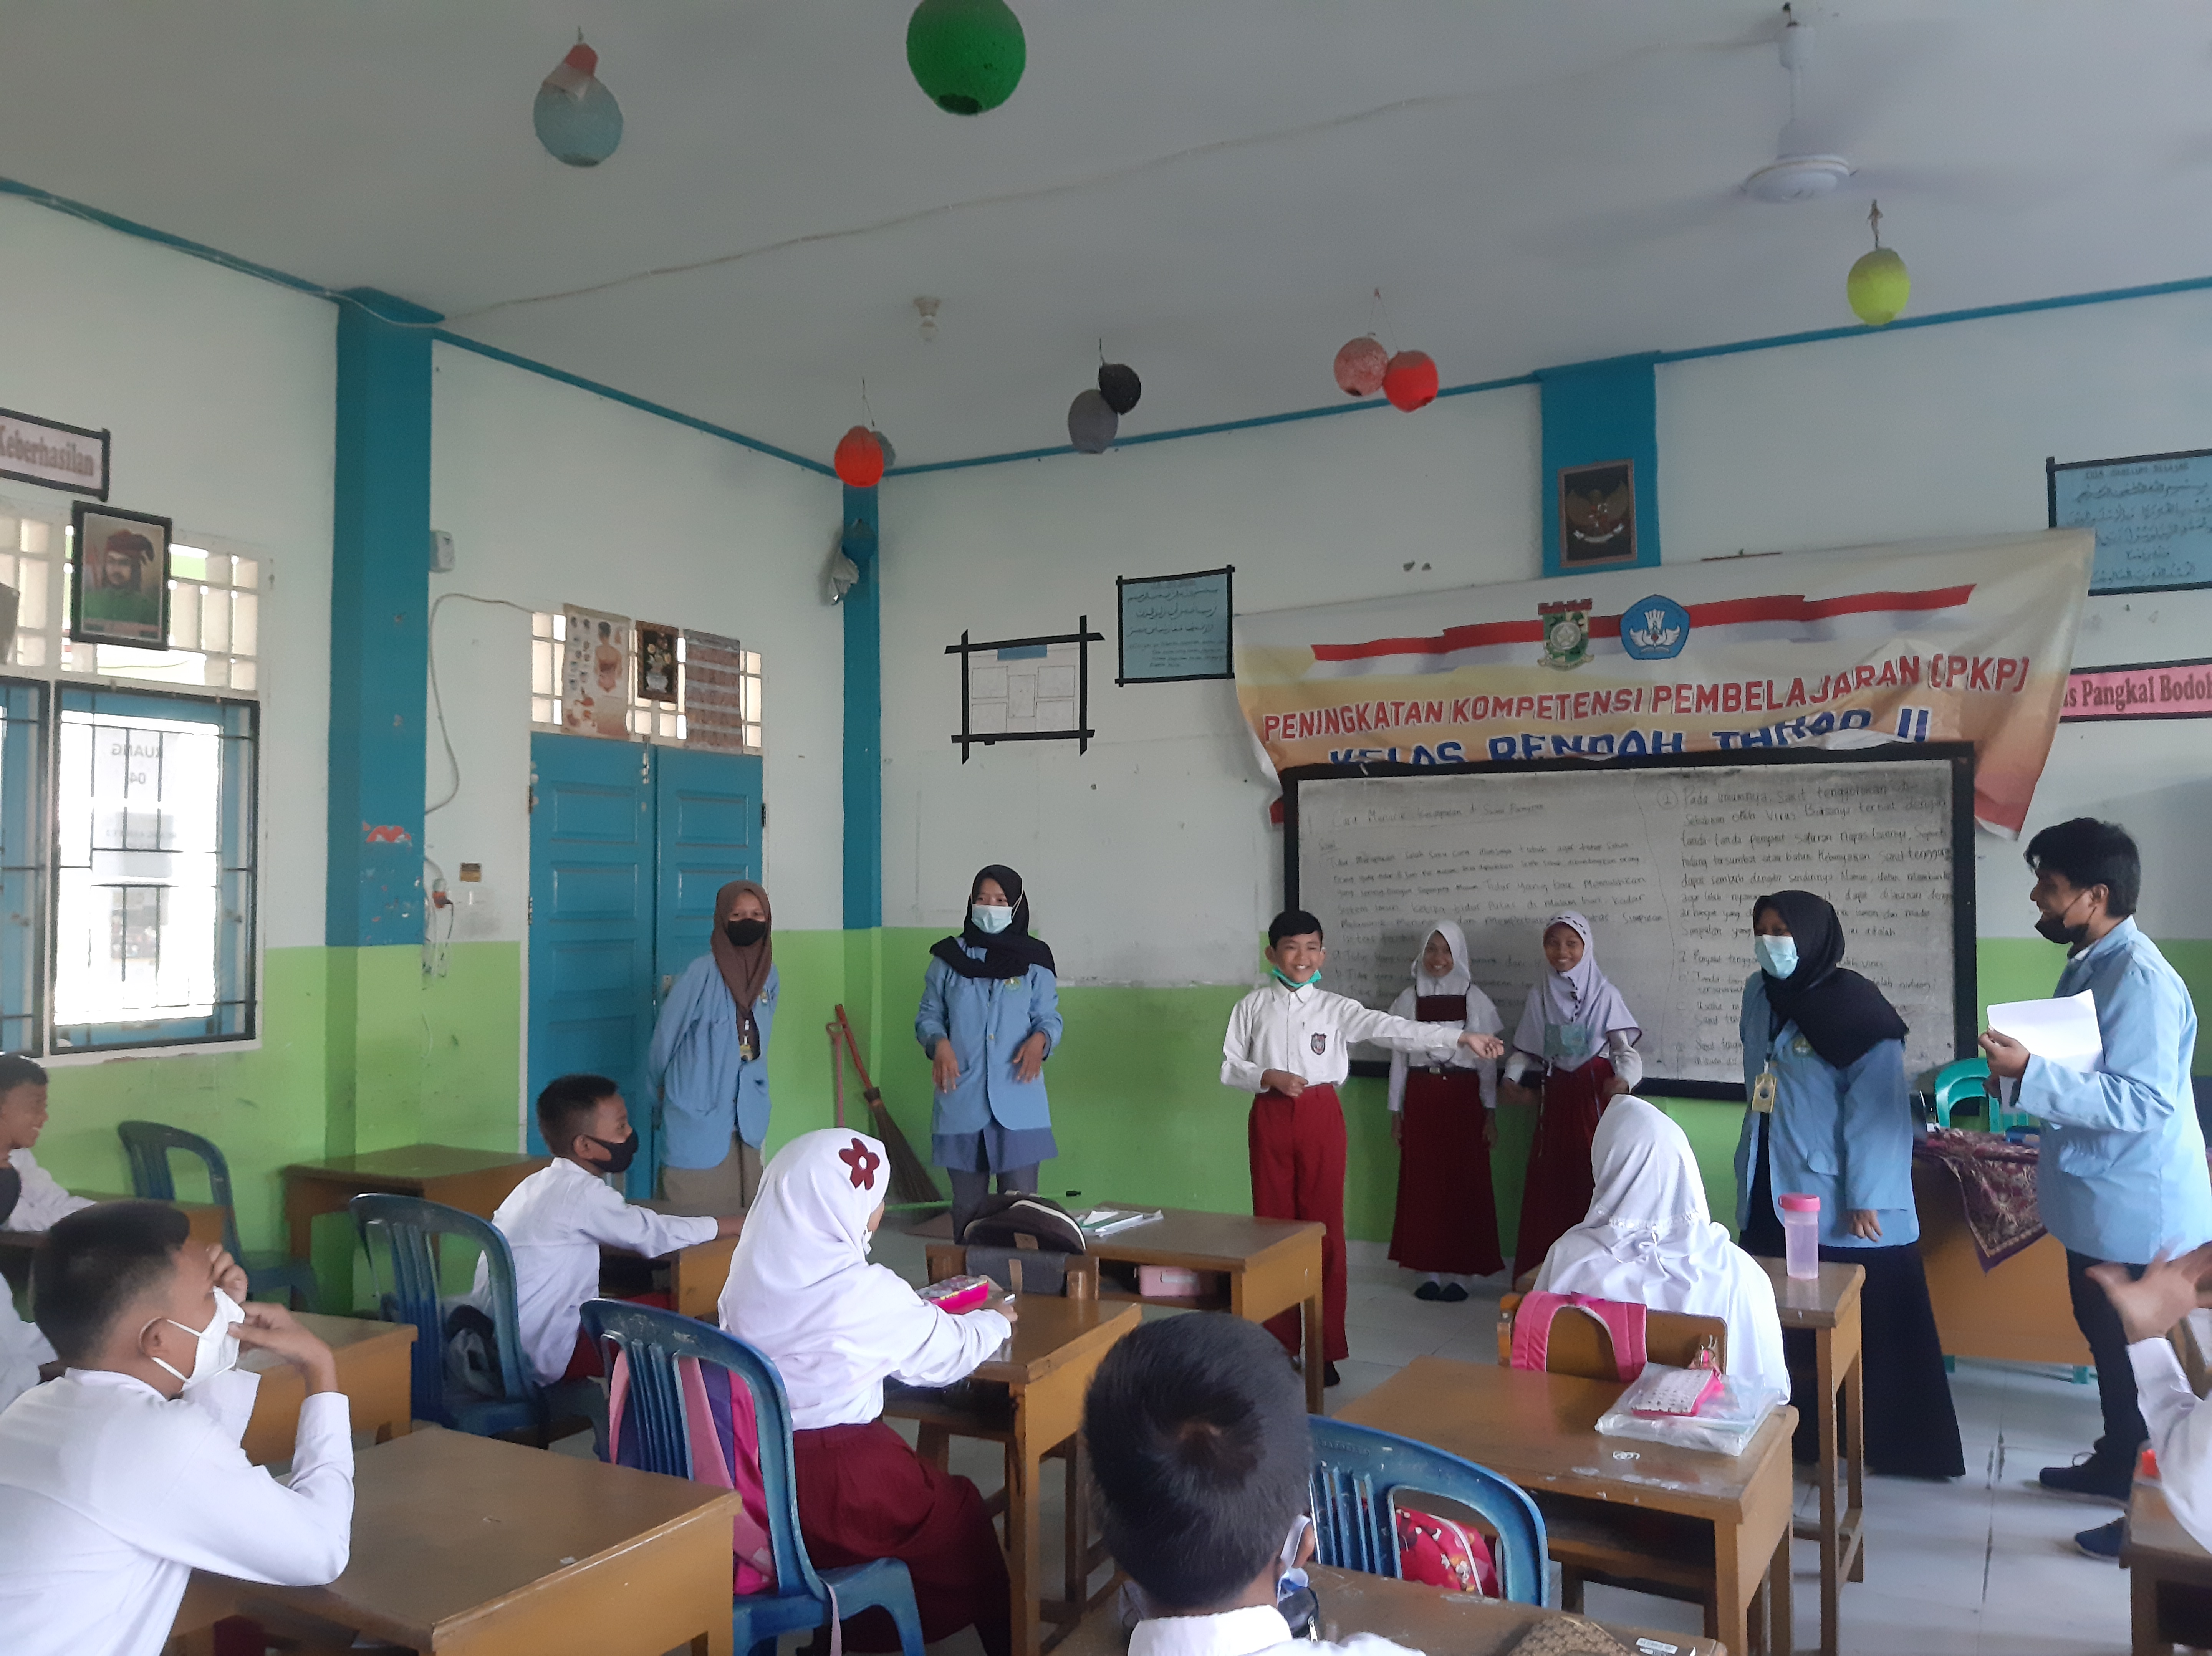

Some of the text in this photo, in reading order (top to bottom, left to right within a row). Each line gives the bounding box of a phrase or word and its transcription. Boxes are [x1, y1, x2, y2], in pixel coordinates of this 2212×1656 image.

[1264, 701, 1444, 741] PENINGKATAN
[1452, 688, 1642, 724] KOMPETENSI
[1652, 655, 1920, 714] PEMBELAJARAN
[2082, 677, 2155, 711] Pangkal
[1897, 709, 1929, 742] II
